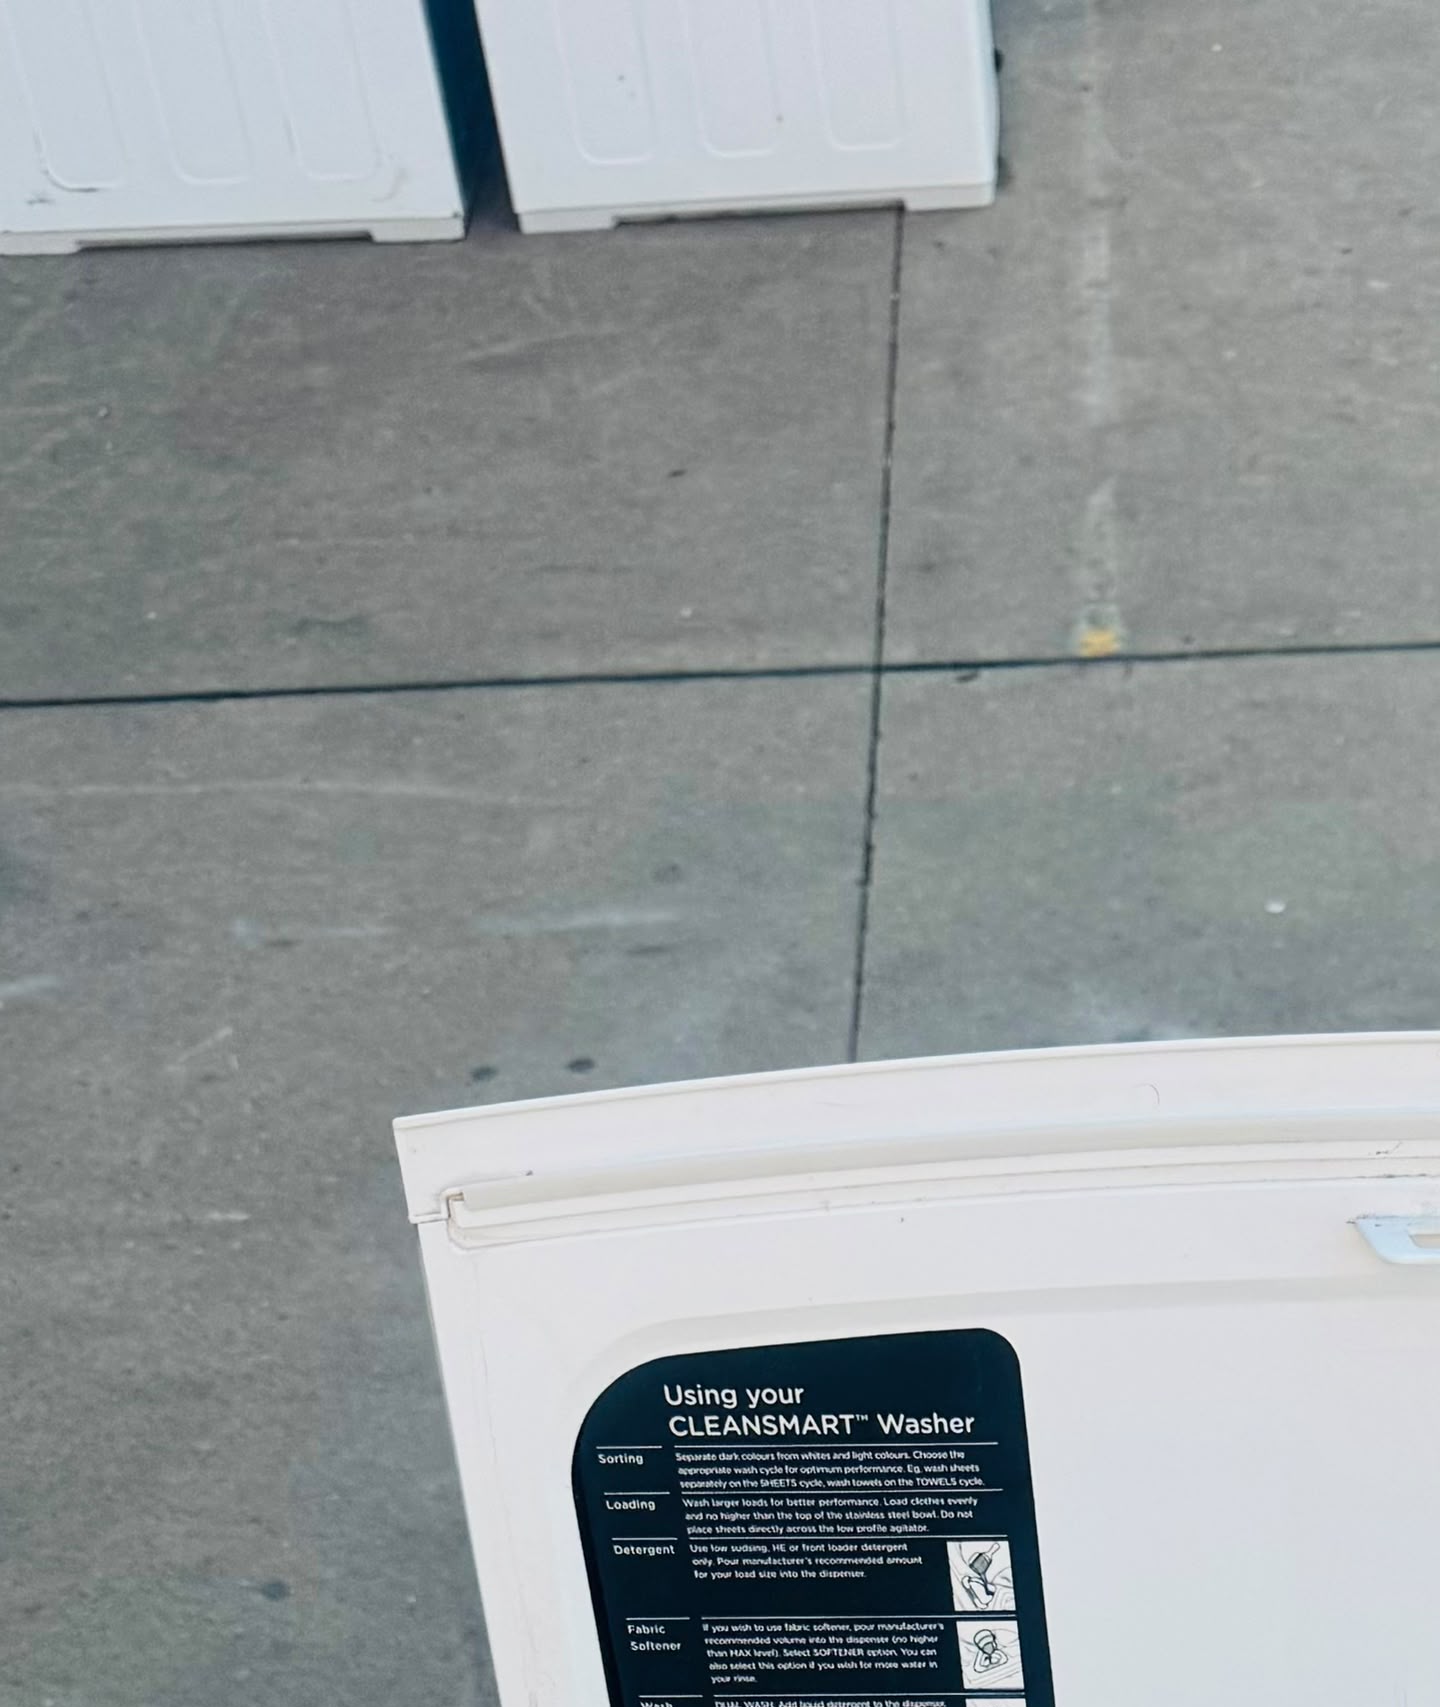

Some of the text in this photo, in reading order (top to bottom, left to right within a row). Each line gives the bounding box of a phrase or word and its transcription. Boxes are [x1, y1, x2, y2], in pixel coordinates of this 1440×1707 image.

[663, 1383, 804, 1409] Using your
[877, 1412, 975, 1435] Washer
[596, 1452, 644, 1465] Sorting
[915, 1476, 957, 1486] TOWELS
[604, 1499, 656, 1511] Loading
[776, 1511, 793, 1520] the
[825, 1511, 843, 1520] the
[939, 1509, 955, 1518] Do
[612, 1544, 676, 1556] Detergent
[626, 1624, 666, 1634] Fabric
[629, 1640, 682, 1651] Softener
